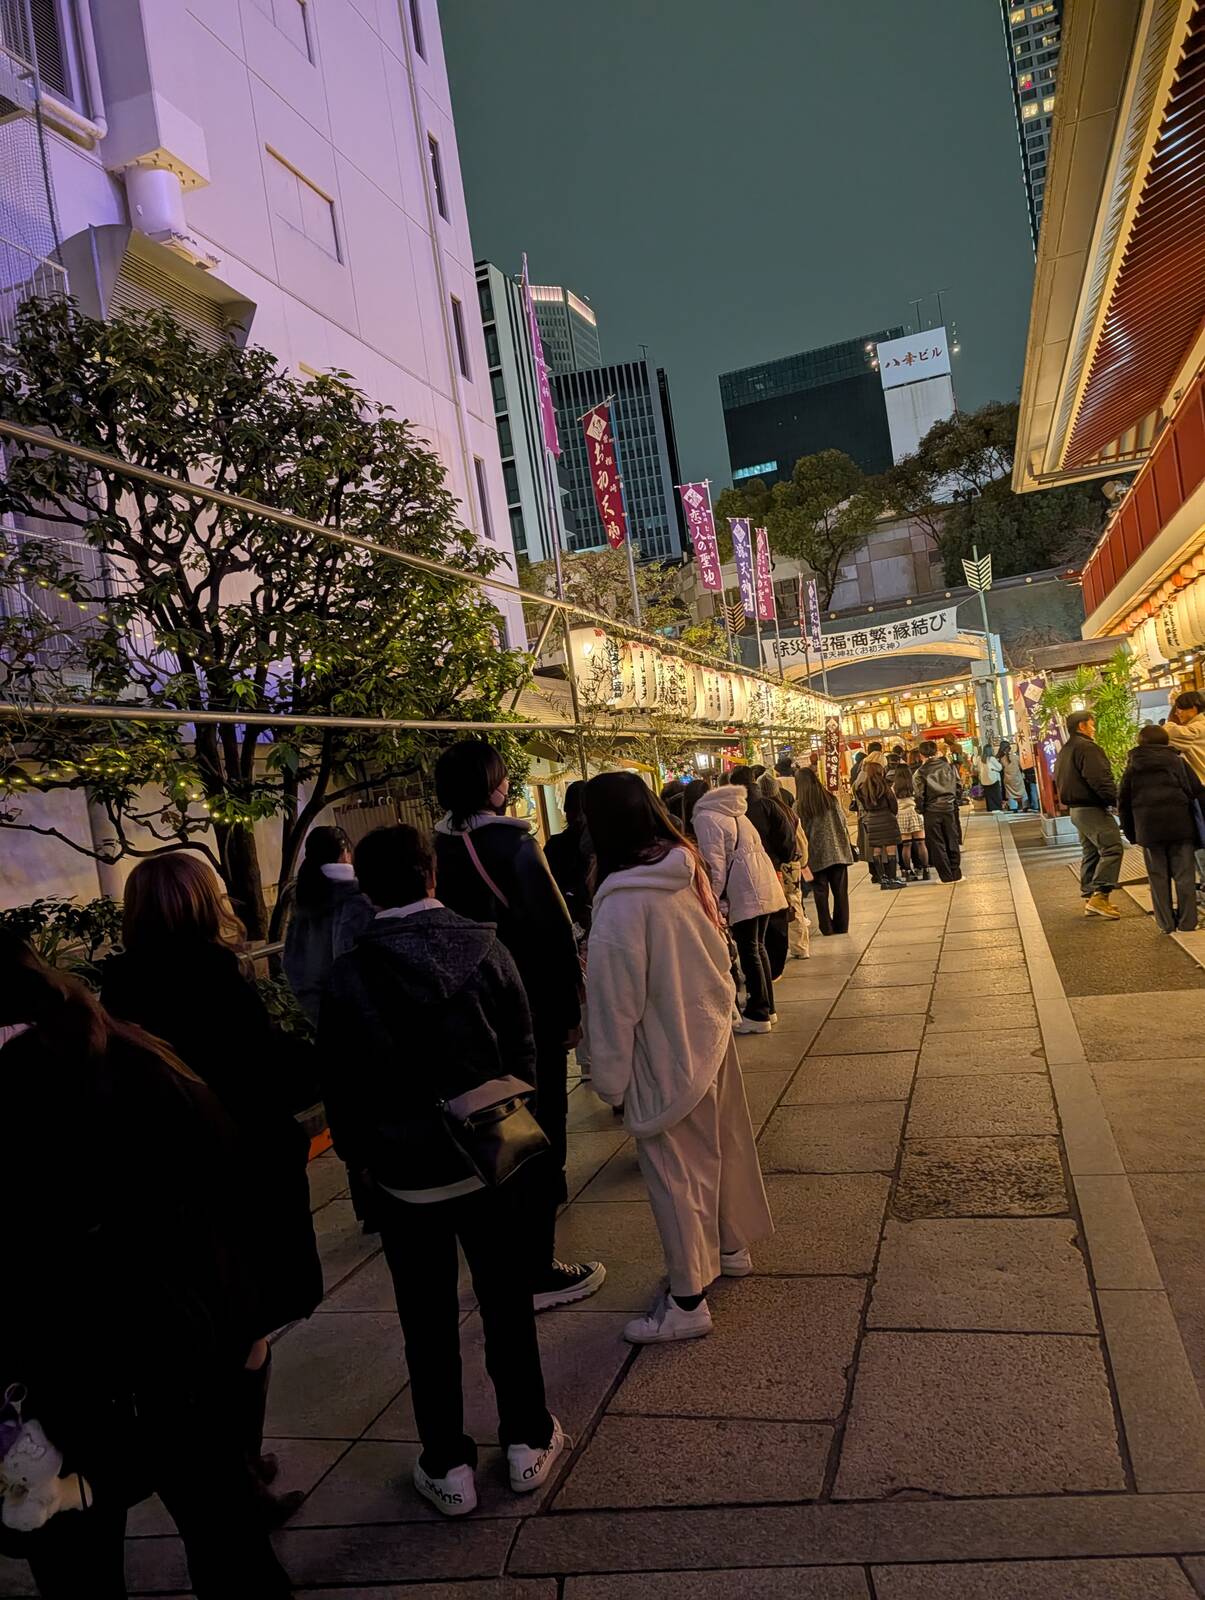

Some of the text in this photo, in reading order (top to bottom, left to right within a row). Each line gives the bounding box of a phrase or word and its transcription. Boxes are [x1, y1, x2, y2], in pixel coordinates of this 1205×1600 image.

[593, 441, 622, 540] お初天神
[688, 508, 717, 586] 恋人の聖地
